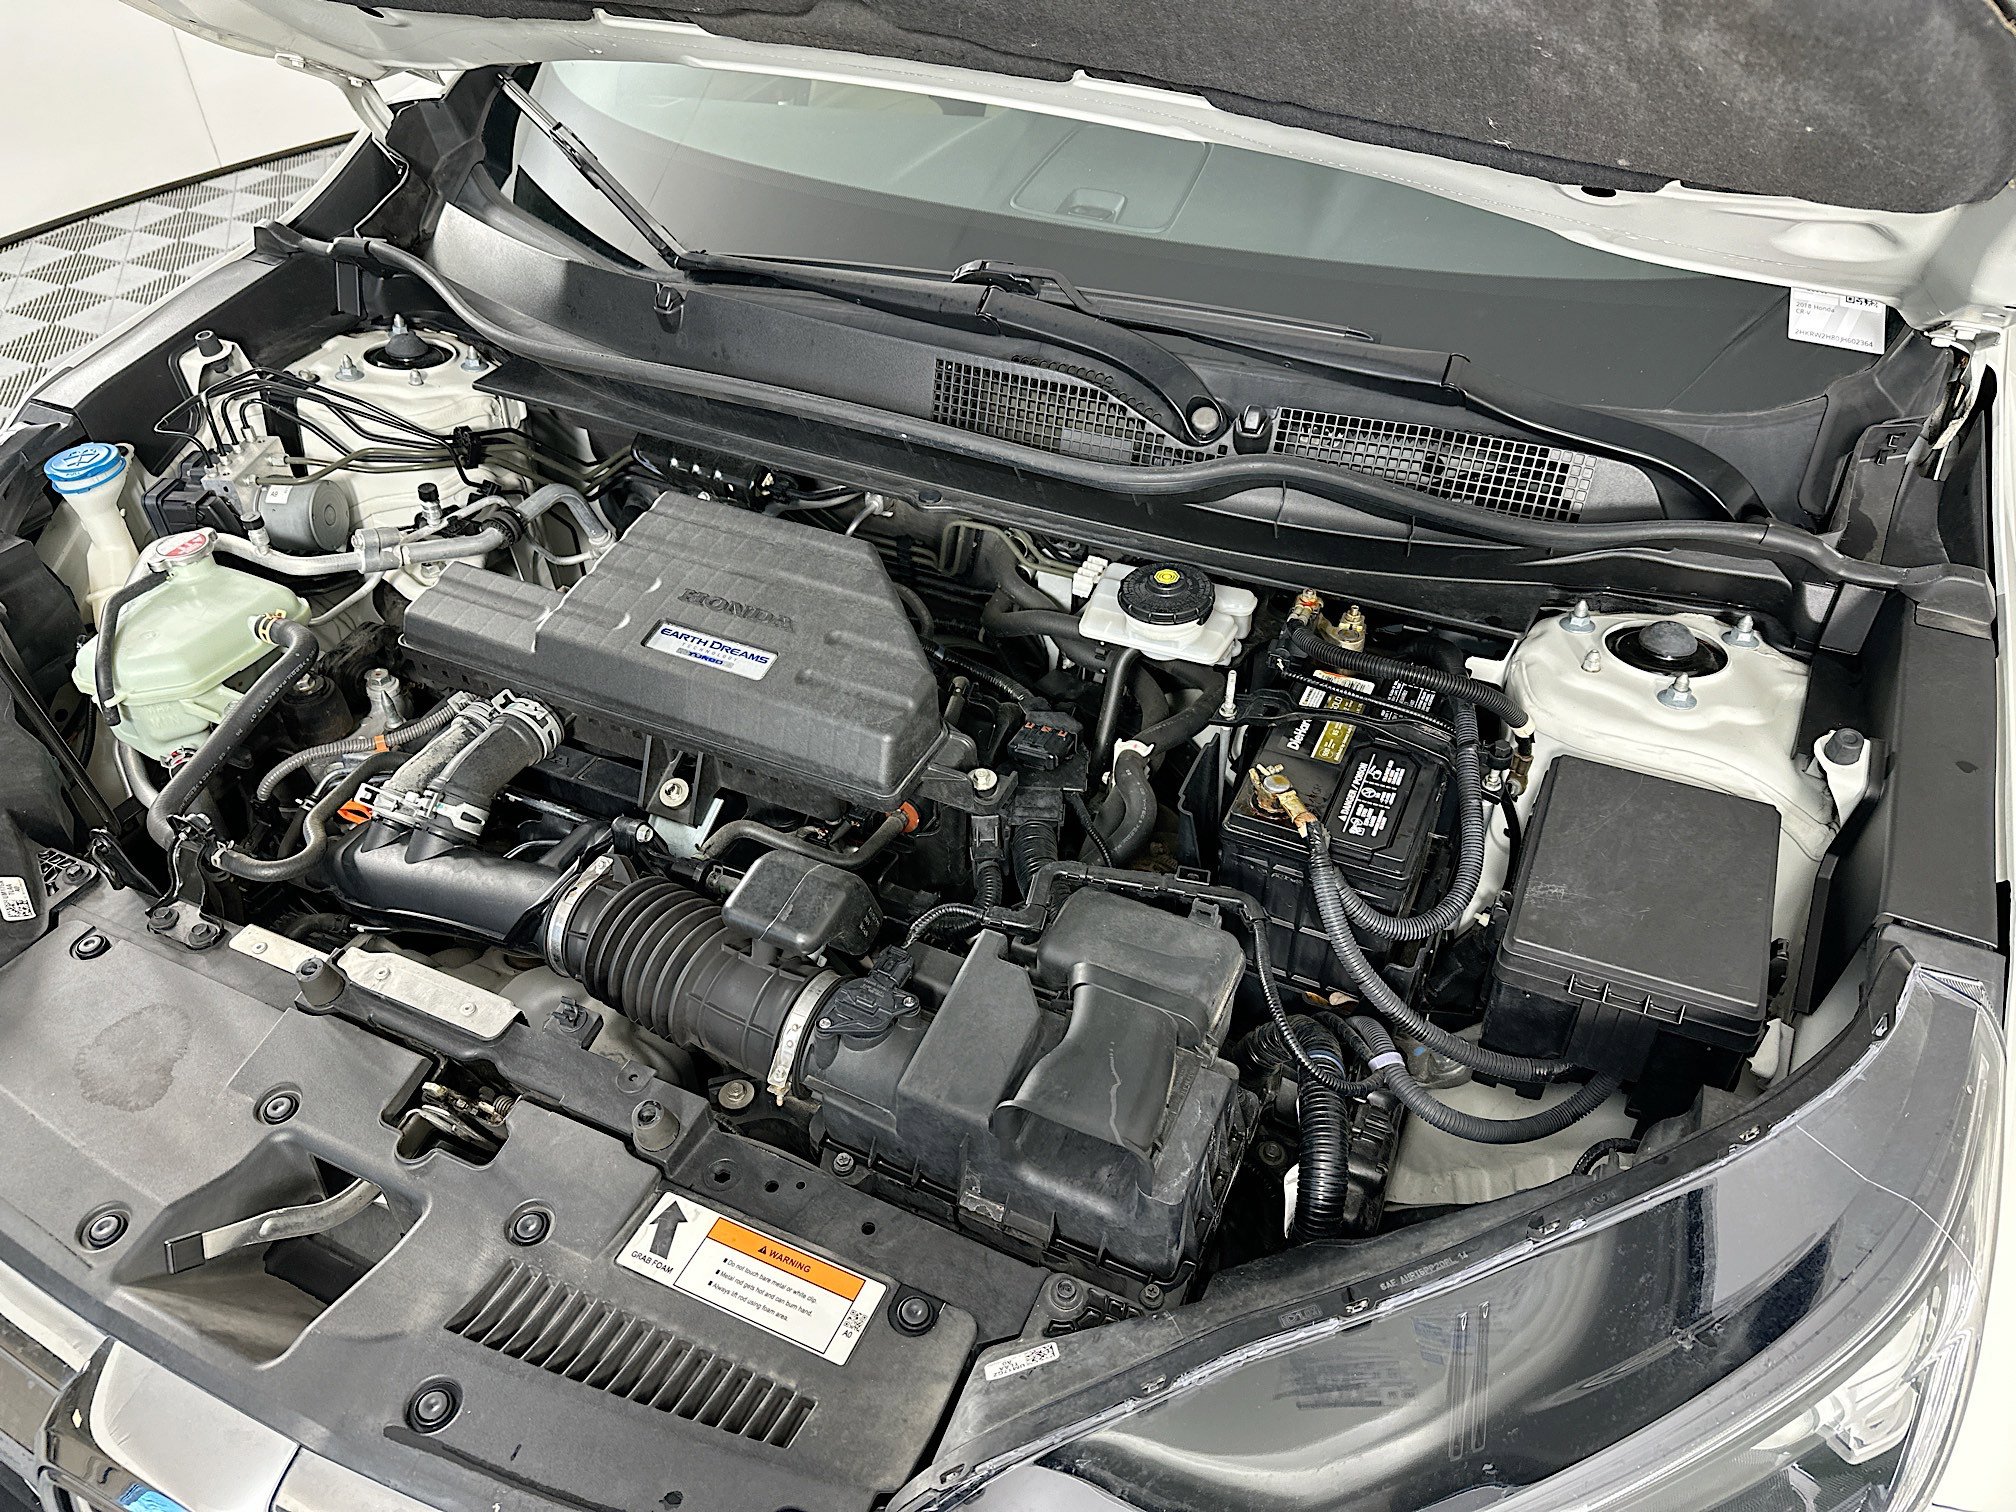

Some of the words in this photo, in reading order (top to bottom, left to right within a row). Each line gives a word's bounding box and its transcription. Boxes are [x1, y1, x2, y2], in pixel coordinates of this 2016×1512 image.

[1814, 305, 1835, 313] Honda
[678, 588, 794, 632] HONDA
[660, 628, 708, 647] EARTH
[710, 640, 770, 664] DREAMS
[688, 652, 724, 665] TURBO
[1286, 719, 1312, 750] DieHar
[1340, 789, 1358, 816] DANGER
[1352, 762, 1368, 786] POISON
[630, 1250, 652, 1265] GRAB
[652, 1259, 674, 1274] FOAM
[768, 1249, 812, 1273] WARNING
[720, 1271, 734, 1282] Metal
[735, 1278, 746, 1288] rod
[746, 1282, 756, 1291] gets
[756, 1286, 765, 1294] hot
[764, 1290, 775, 1299] and
[786, 1298, 798, 1310] burn
[798, 1305, 812, 1317] hand.
[744, 1266, 759, 1277] touch
[758, 1271, 772, 1282] bare
[772, 1277, 786, 1290] metal
[793, 1288, 807, 1300] white
[807, 1294, 817, 1304] clip.
[1379, 1278, 1398, 1291] SAE
[712, 1282, 731, 1297] Always
[740, 1294, 748, 1304] rod
[748, 1299, 762, 1310] using
[761, 1304, 776, 1316] foam
[776, 1312, 788, 1322] area.
